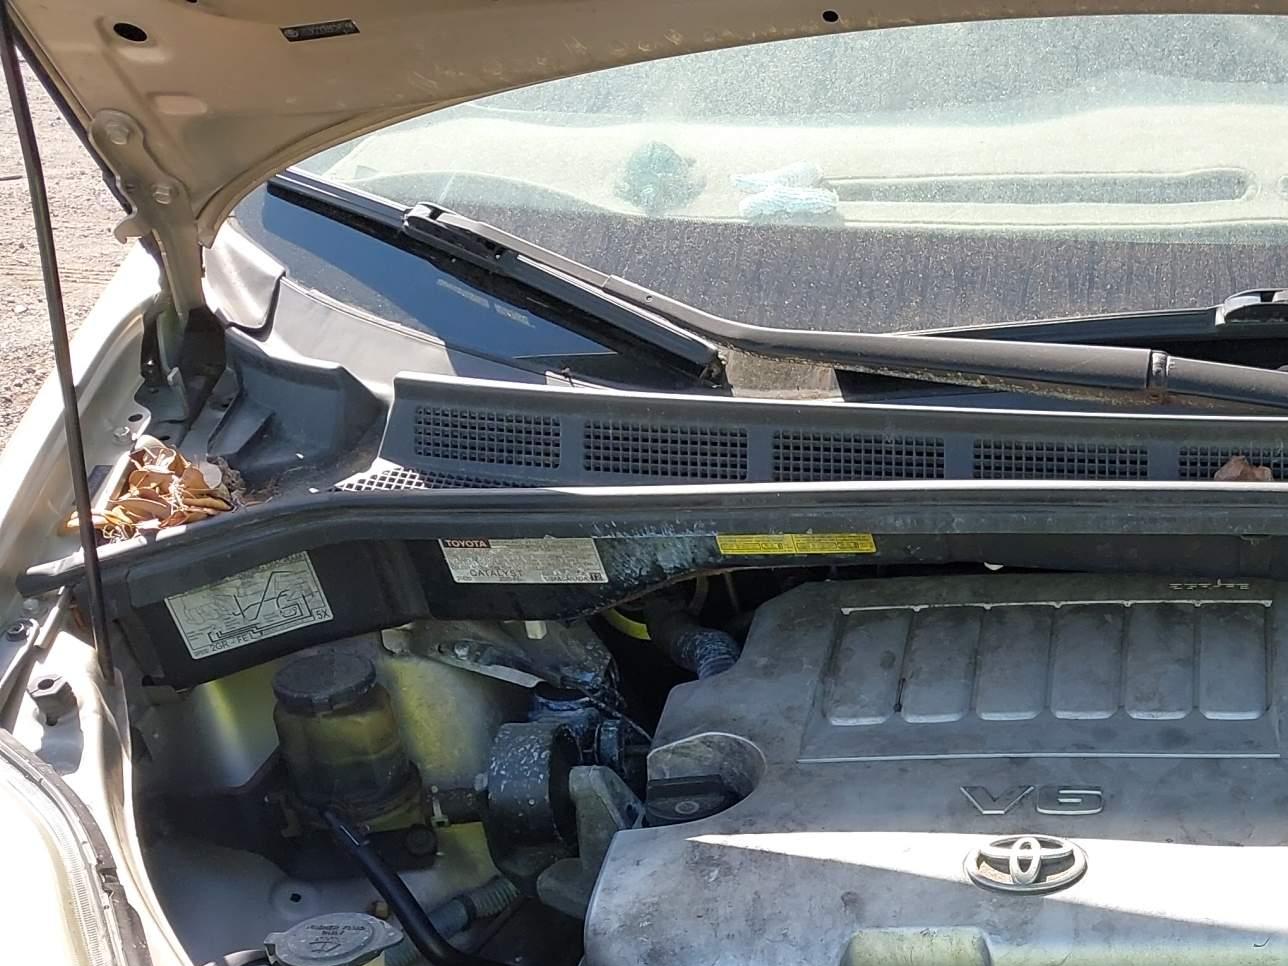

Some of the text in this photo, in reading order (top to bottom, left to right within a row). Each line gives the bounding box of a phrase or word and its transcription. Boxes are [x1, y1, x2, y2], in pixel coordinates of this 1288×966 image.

[445, 539, 488, 548] TOYOTA
[469, 568, 523, 577] CATALYST
[316, 610, 329, 620] 5X
[960, 785, 1104, 815] V6
